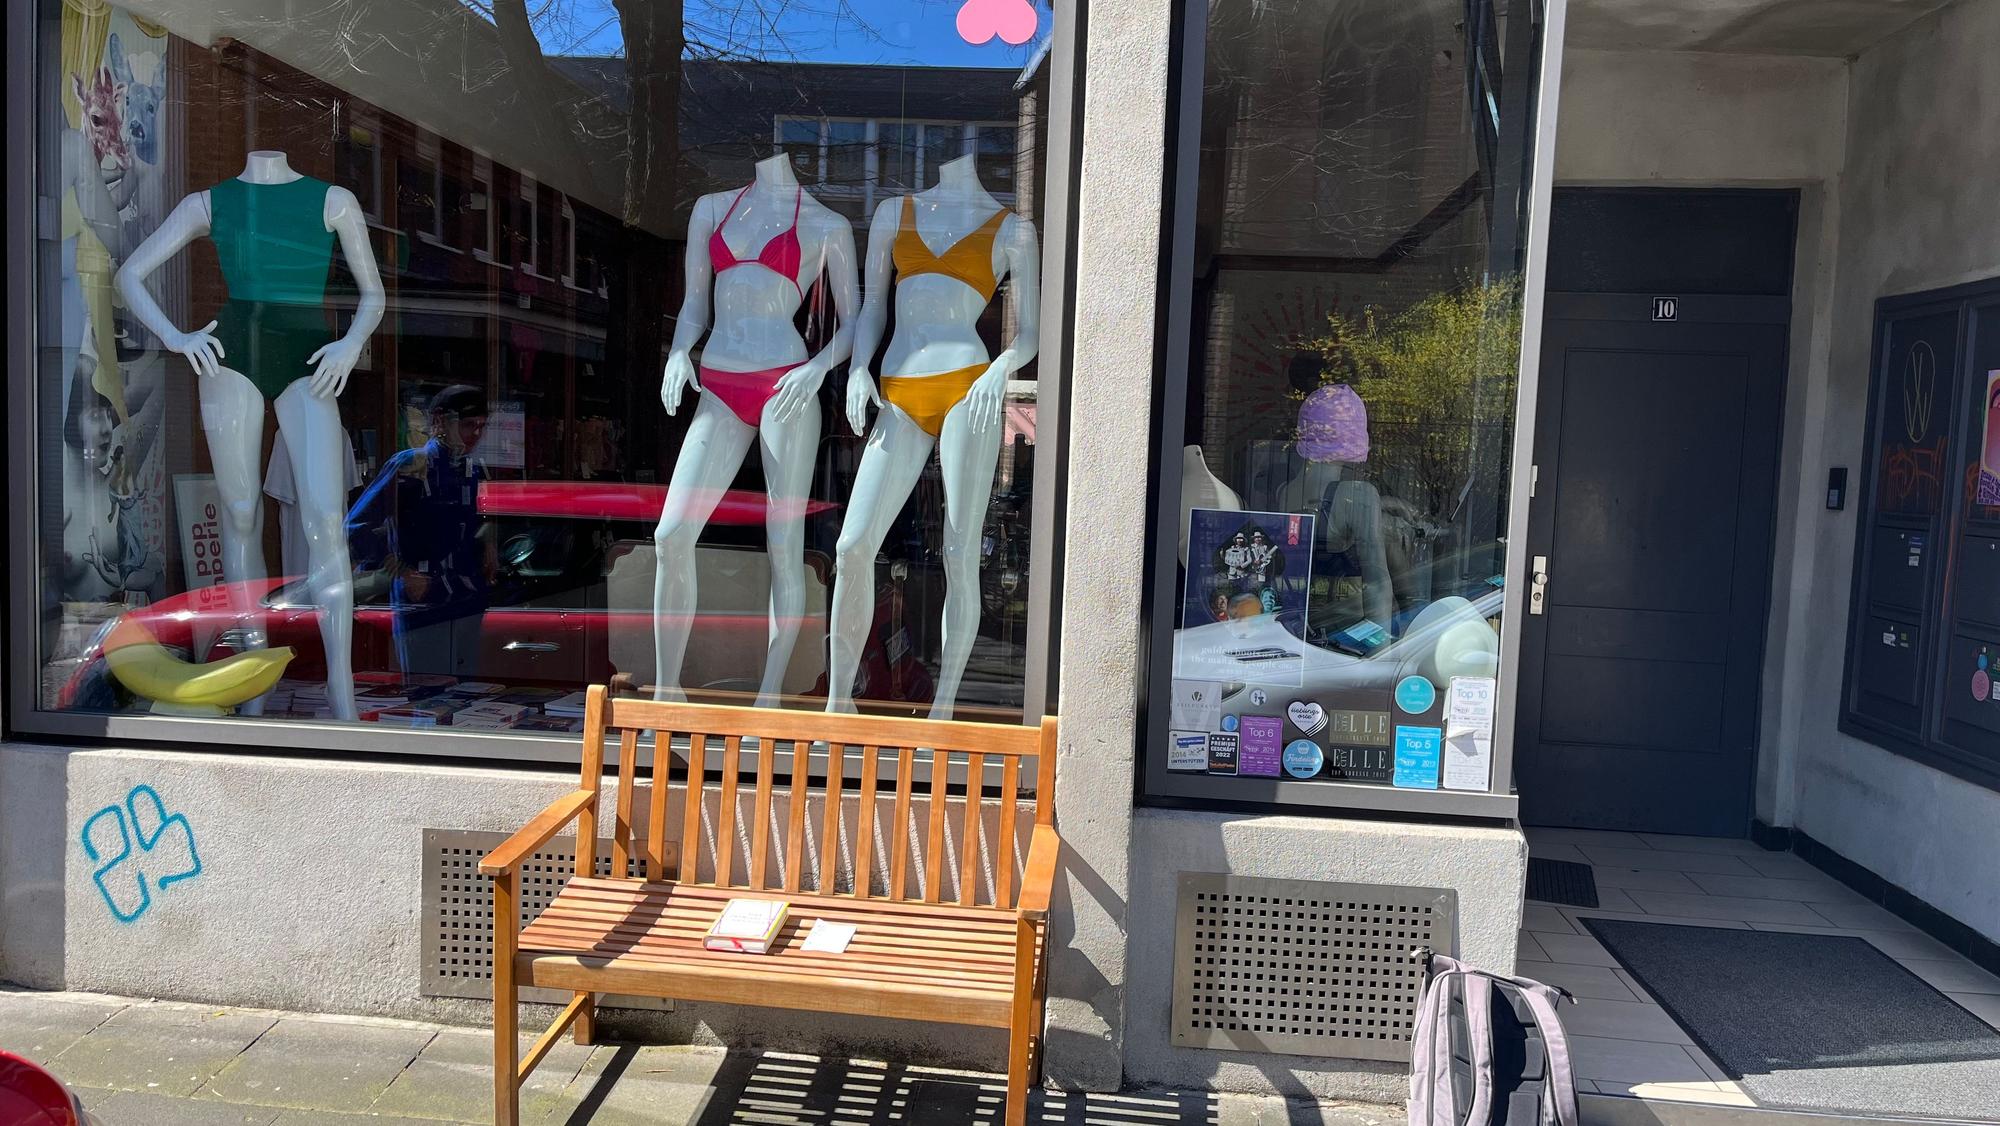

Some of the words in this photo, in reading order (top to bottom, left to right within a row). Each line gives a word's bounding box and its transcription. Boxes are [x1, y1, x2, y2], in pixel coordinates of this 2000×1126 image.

[1656, 300, 1675, 318] 10
[191, 523, 212, 577] pop
[198, 588, 213, 612] le
[1457, 688, 1474, 699] Top
[1478, 690, 1487, 699] 10
[1334, 713, 1387, 734] ELLE
[1249, 727, 1266, 739] Top
[1267, 728, 1274, 738] 6
[1210, 740, 1236, 748] PREMIUM
[1210, 745, 1236, 753] GESCHÄFT
[1405, 738, 1423, 750] Top
[1333, 748, 1386, 769] ELLE
